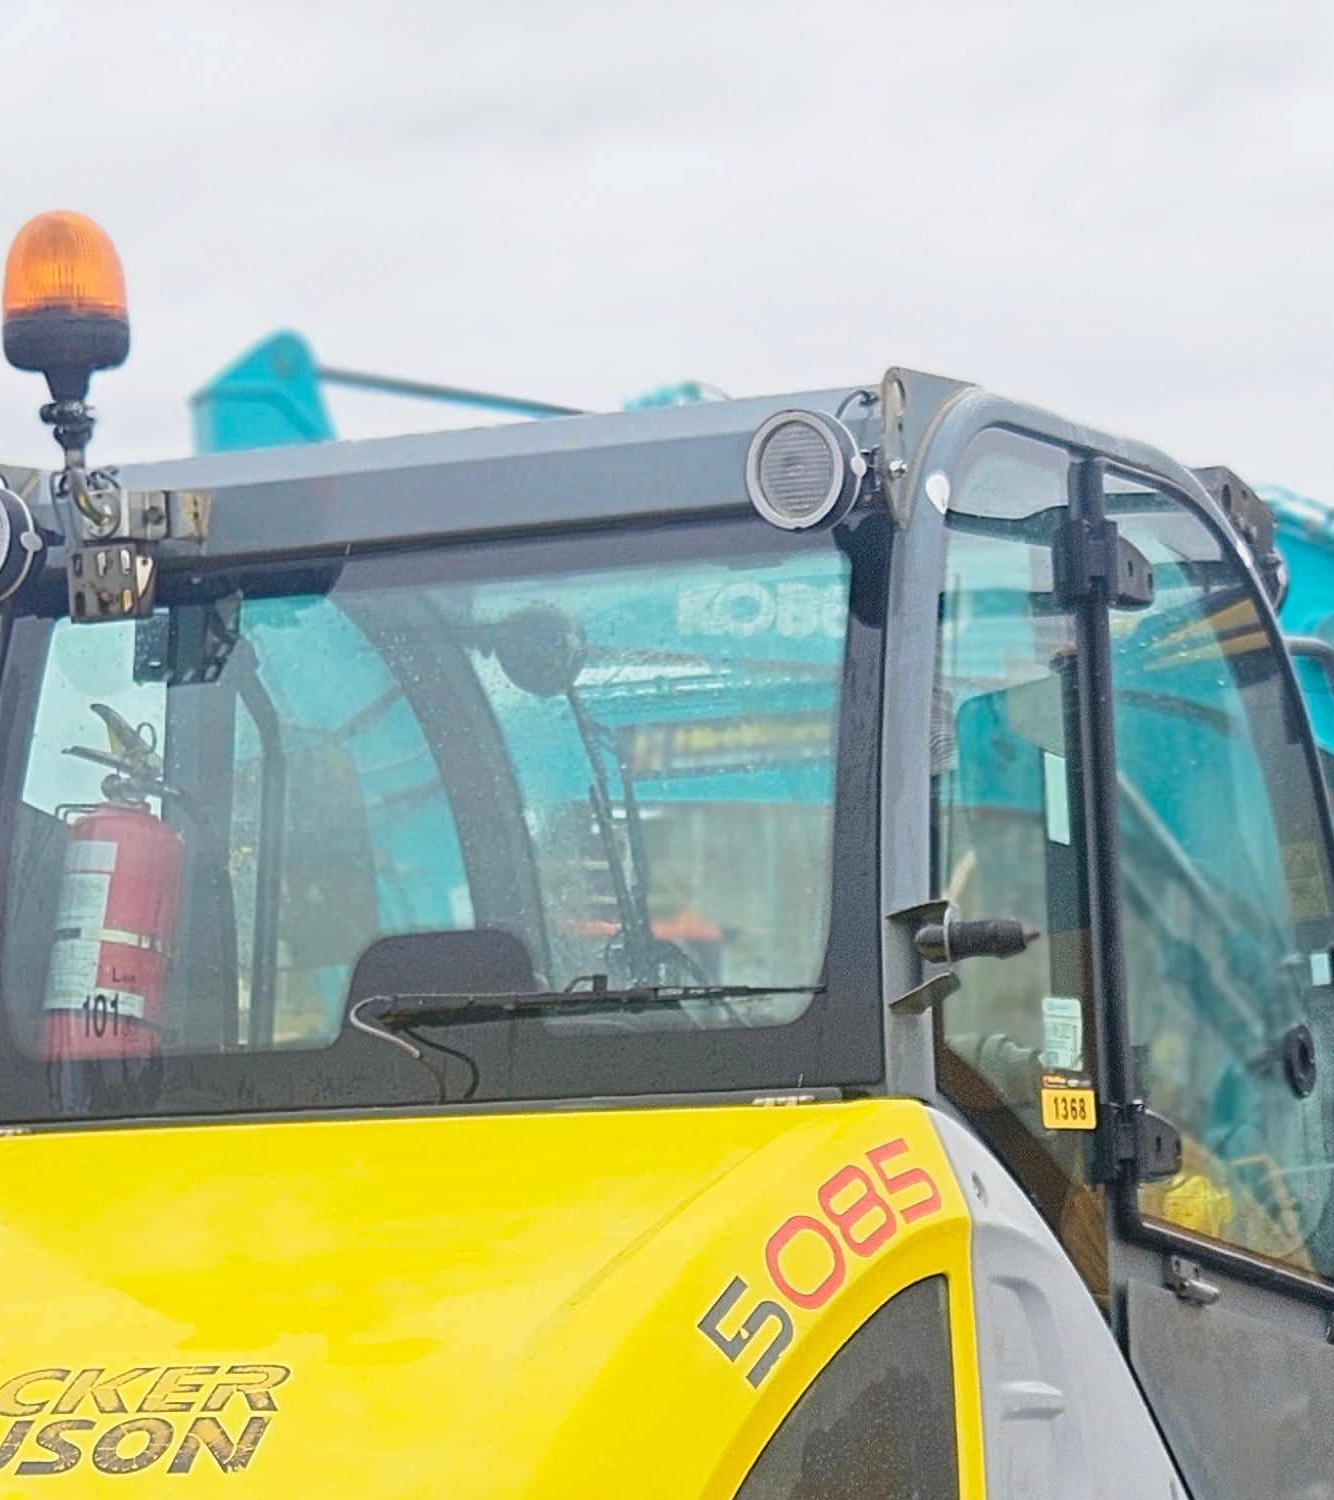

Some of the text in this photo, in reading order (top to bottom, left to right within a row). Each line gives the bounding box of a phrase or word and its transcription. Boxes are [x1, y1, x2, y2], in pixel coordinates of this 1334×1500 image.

[82, 993, 119, 1038] 101
[1053, 1096, 1088, 1121] 1368
[697, 1137, 943, 1390] 5085
